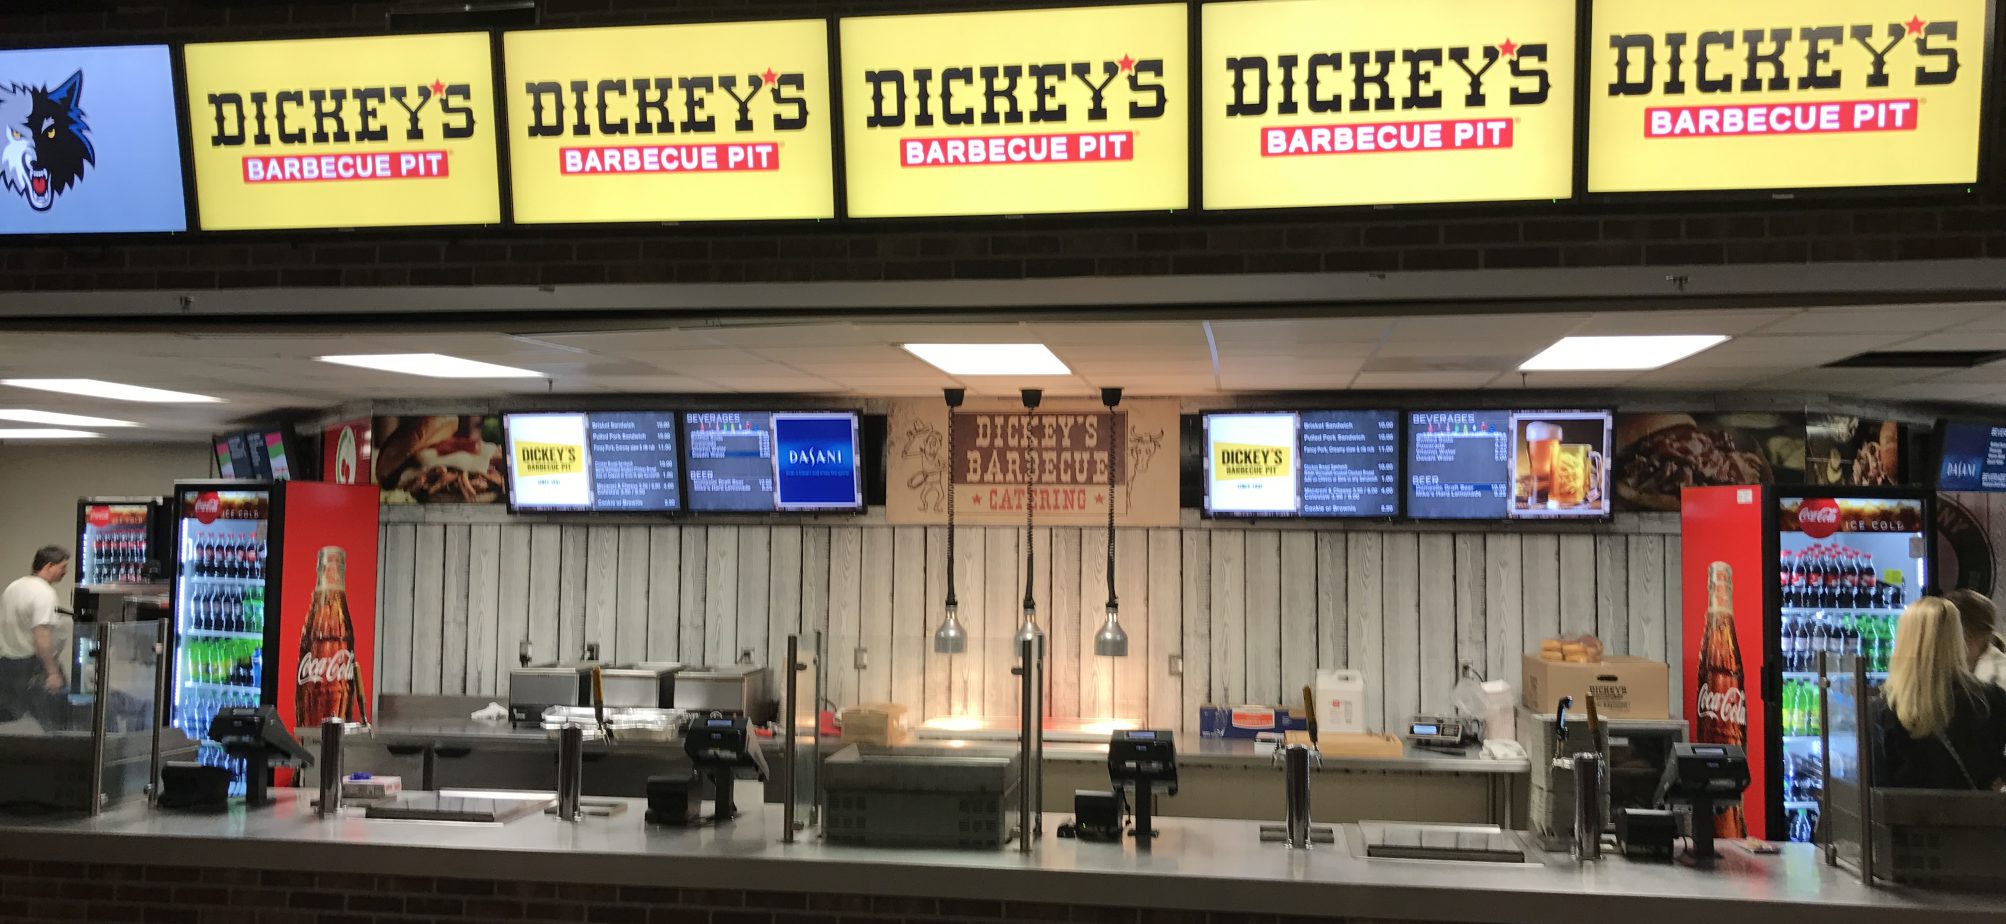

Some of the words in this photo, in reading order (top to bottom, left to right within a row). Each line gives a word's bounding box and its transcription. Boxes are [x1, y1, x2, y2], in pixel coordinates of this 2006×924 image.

[1608, 15, 1960, 98] DICKEY'S
[1226, 38, 1552, 117] DICKEY'S
[525, 67, 809, 137] DICKEY'S
[865, 53, 1168, 128] DICKEY'S
[207, 79, 477, 148] DICKEY'S
[1650, 104, 1840, 136] BARBECUE
[1852, 102, 1911, 129] PIT
[1267, 123, 1444, 154] BARBECUE
[1454, 121, 1507, 147] PIT
[564, 147, 718, 173] BARBECUE
[728, 145, 773, 168] PIT
[905, 136, 1068, 165] BARBECUE
[1078, 134, 1127, 160] PIT
[248, 154, 391, 181] BARBECUE
[400, 153, 442, 177] PIT
[687, 413, 740, 424] BEVERAGES
[1325, 421, 1353, 430] Sandwich
[1413, 413, 1475, 425] BEVERAGES
[976, 415, 1098, 448] DICKEY'S
[1304, 433, 1322, 441] Pulled
[1323, 433, 1336, 441] Pork
[1337, 433, 1366, 441] Sandwich
[521, 447, 576, 463] DICKEY'S
[789, 446, 842, 467] DASANI
[1221, 448, 1283, 465] DICKEY'S
[527, 463, 560, 473] BARBECUE
[561, 463, 572, 472] PIT
[690, 470, 713, 480] BEER
[966, 450, 1110, 484] BARBECUE
[1226, 465, 1263, 475] BARBECUE
[1265, 465, 1277, 474] PIT
[1413, 475, 1439, 485] BEER
[989, 488, 1086, 511] CATERING
[1845, 520, 1865, 530] ICE
[1871, 520, 1904, 530] COLD
